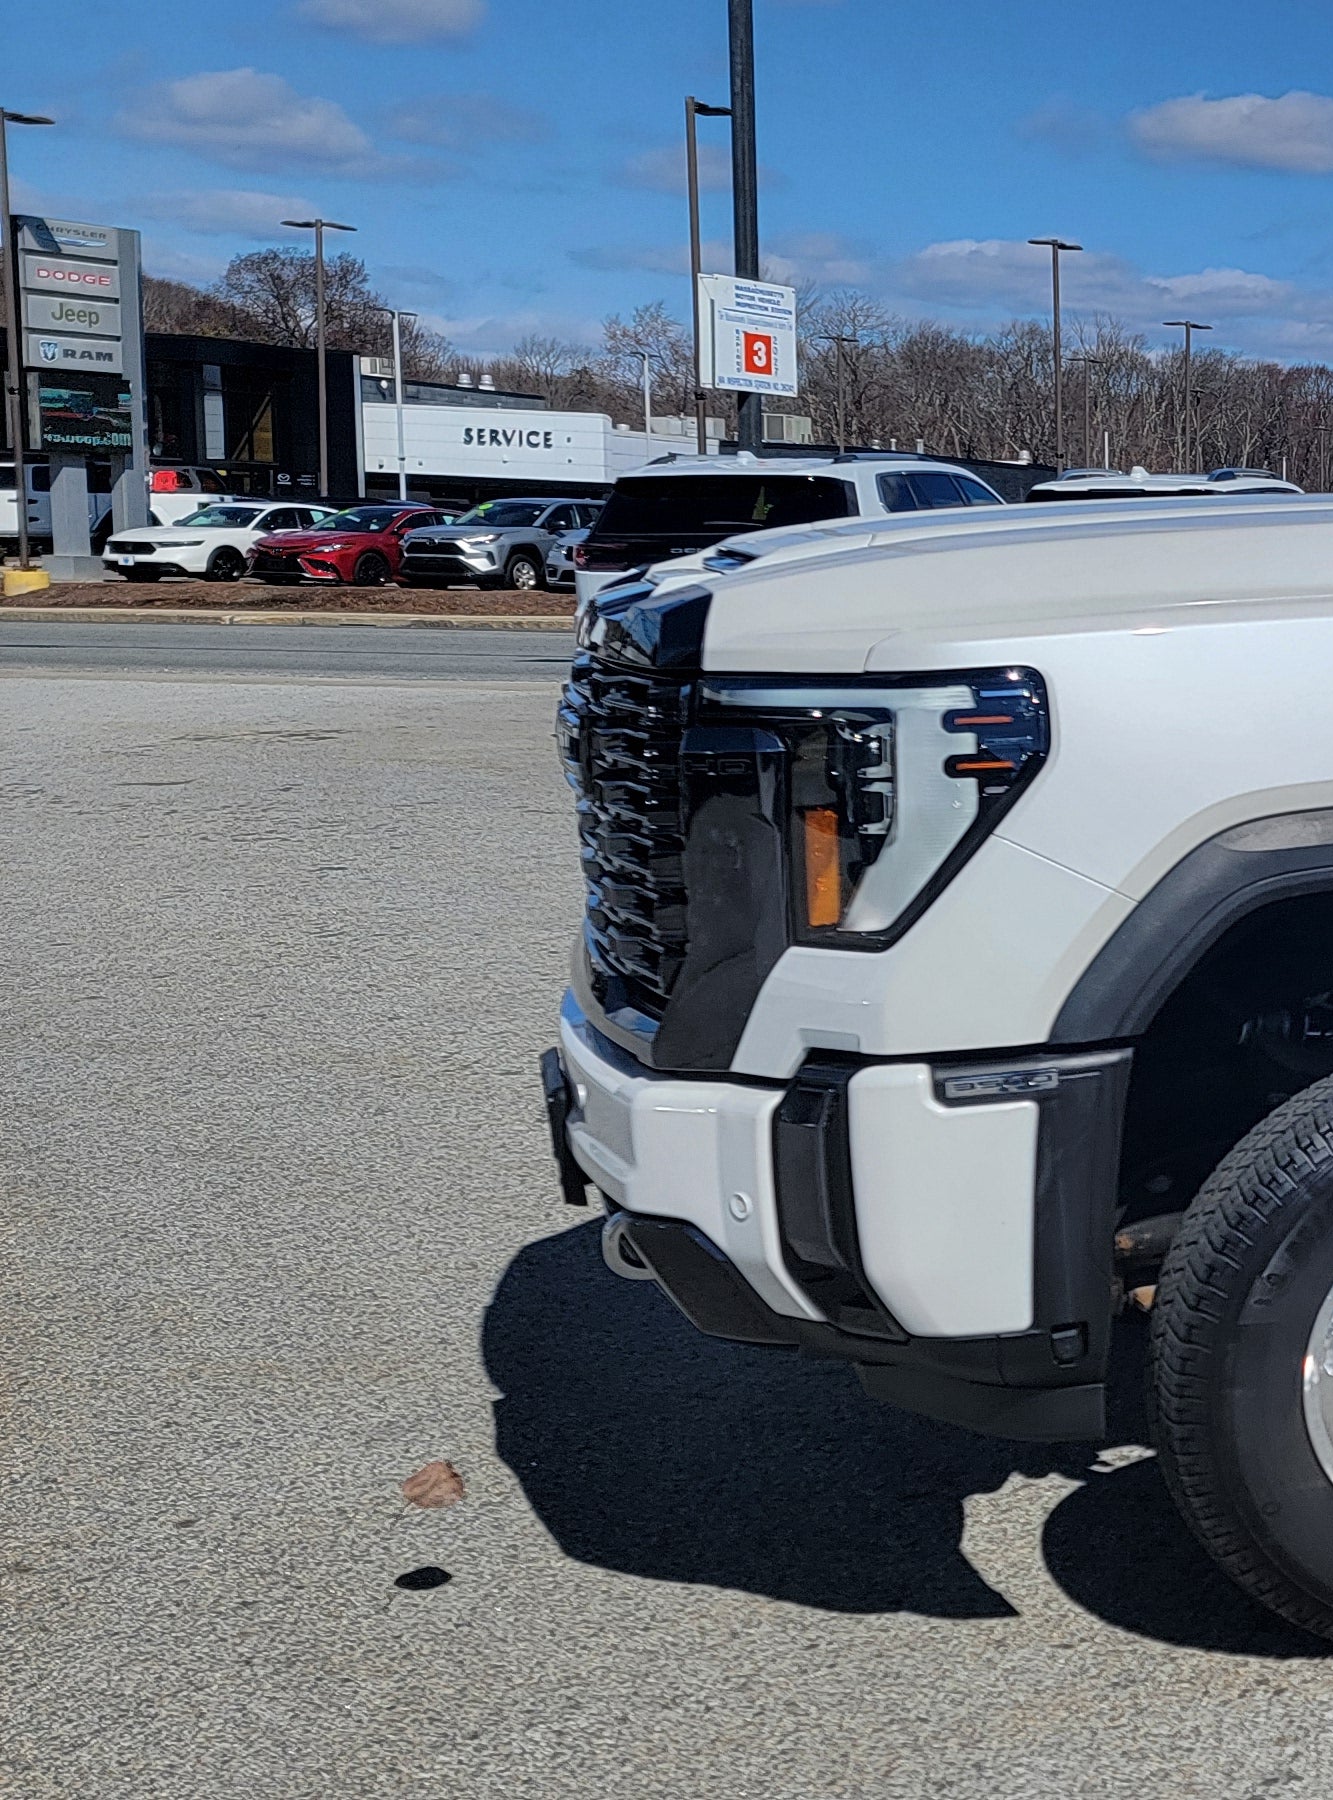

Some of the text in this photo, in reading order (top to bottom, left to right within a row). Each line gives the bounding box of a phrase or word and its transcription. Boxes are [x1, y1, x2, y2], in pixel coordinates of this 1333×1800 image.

[36, 223, 107, 240] CHRYSLER
[37, 268, 111, 287] DODGE
[51, 302, 100, 329] Jeep
[62, 348, 113, 363] RAM
[752, 341, 767, 368] 3
[463, 427, 553, 449] SERVICE
